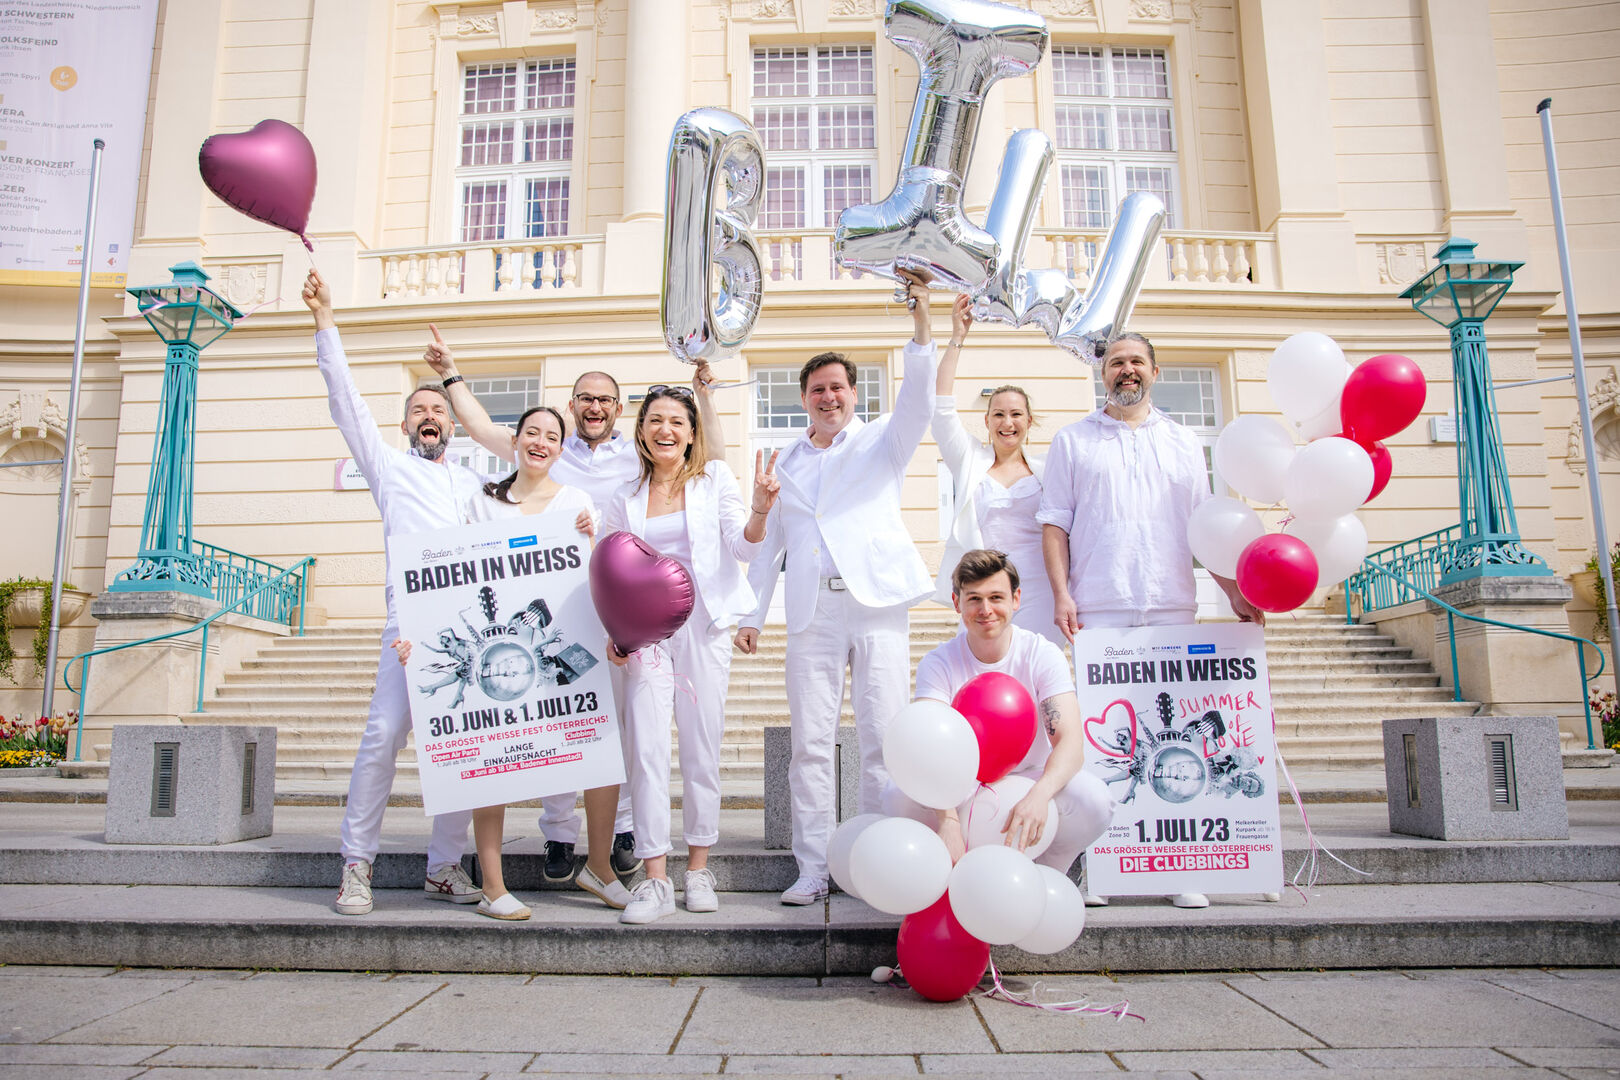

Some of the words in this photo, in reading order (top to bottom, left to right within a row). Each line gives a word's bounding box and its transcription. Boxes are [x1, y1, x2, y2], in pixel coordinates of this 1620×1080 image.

[4, 9, 75, 19] SCHWESTERN
[0, 36, 58, 46] OLKSFEIND
[26, 158, 74, 169] KONZERT
[421, 549, 453, 560] Baden
[405, 560, 478, 594] BADEN
[481, 556, 505, 581] IN
[508, 545, 581, 577] WEISS
[1104, 646, 1134, 656] Baden
[1087, 661, 1156, 685] BADEN
[1160, 660, 1183, 682] IN
[1186, 657, 1257, 681] WEISS
[1179, 690, 1262, 718] SUMMER
[429, 715, 459, 737] 30.
[462, 707, 500, 732] JUNI
[504, 708, 517, 725] &
[520, 702, 534, 722] 1.
[537, 696, 571, 719] JULI
[574, 691, 598, 713] 23
[1228, 714, 1251, 732] of
[425, 742, 443, 752] DAS
[445, 735, 485, 749] GRÖSSTE
[487, 728, 521, 741] WEISSE
[523, 726, 543, 736] FEST
[546, 714, 609, 732] ÖSTERREICHS!
[566, 729, 595, 740] Clubbing
[504, 742, 534, 754] LANGE
[1202, 726, 1257, 758] LOVE
[433, 752, 450, 762] Open
[462, 748, 479, 757] Party
[484, 748, 557, 767] EINKAUFSNACHT
[520, 759, 547, 769] Badener
[548, 752, 582, 763] Innenstadt
[1134, 819, 1151, 843] 1.
[1154, 819, 1197, 842] JULI
[1201, 817, 1230, 841] 23
[1113, 845, 1152, 854] GRÖSSTE
[1154, 845, 1187, 853] WEISSE
[1189, 845, 1209, 853] FEST
[1212, 844, 1273, 852] ÖSTERREICHS!
[1122, 857, 1150, 872] DIE
[1153, 854, 1247, 872] CLUBBINGS
